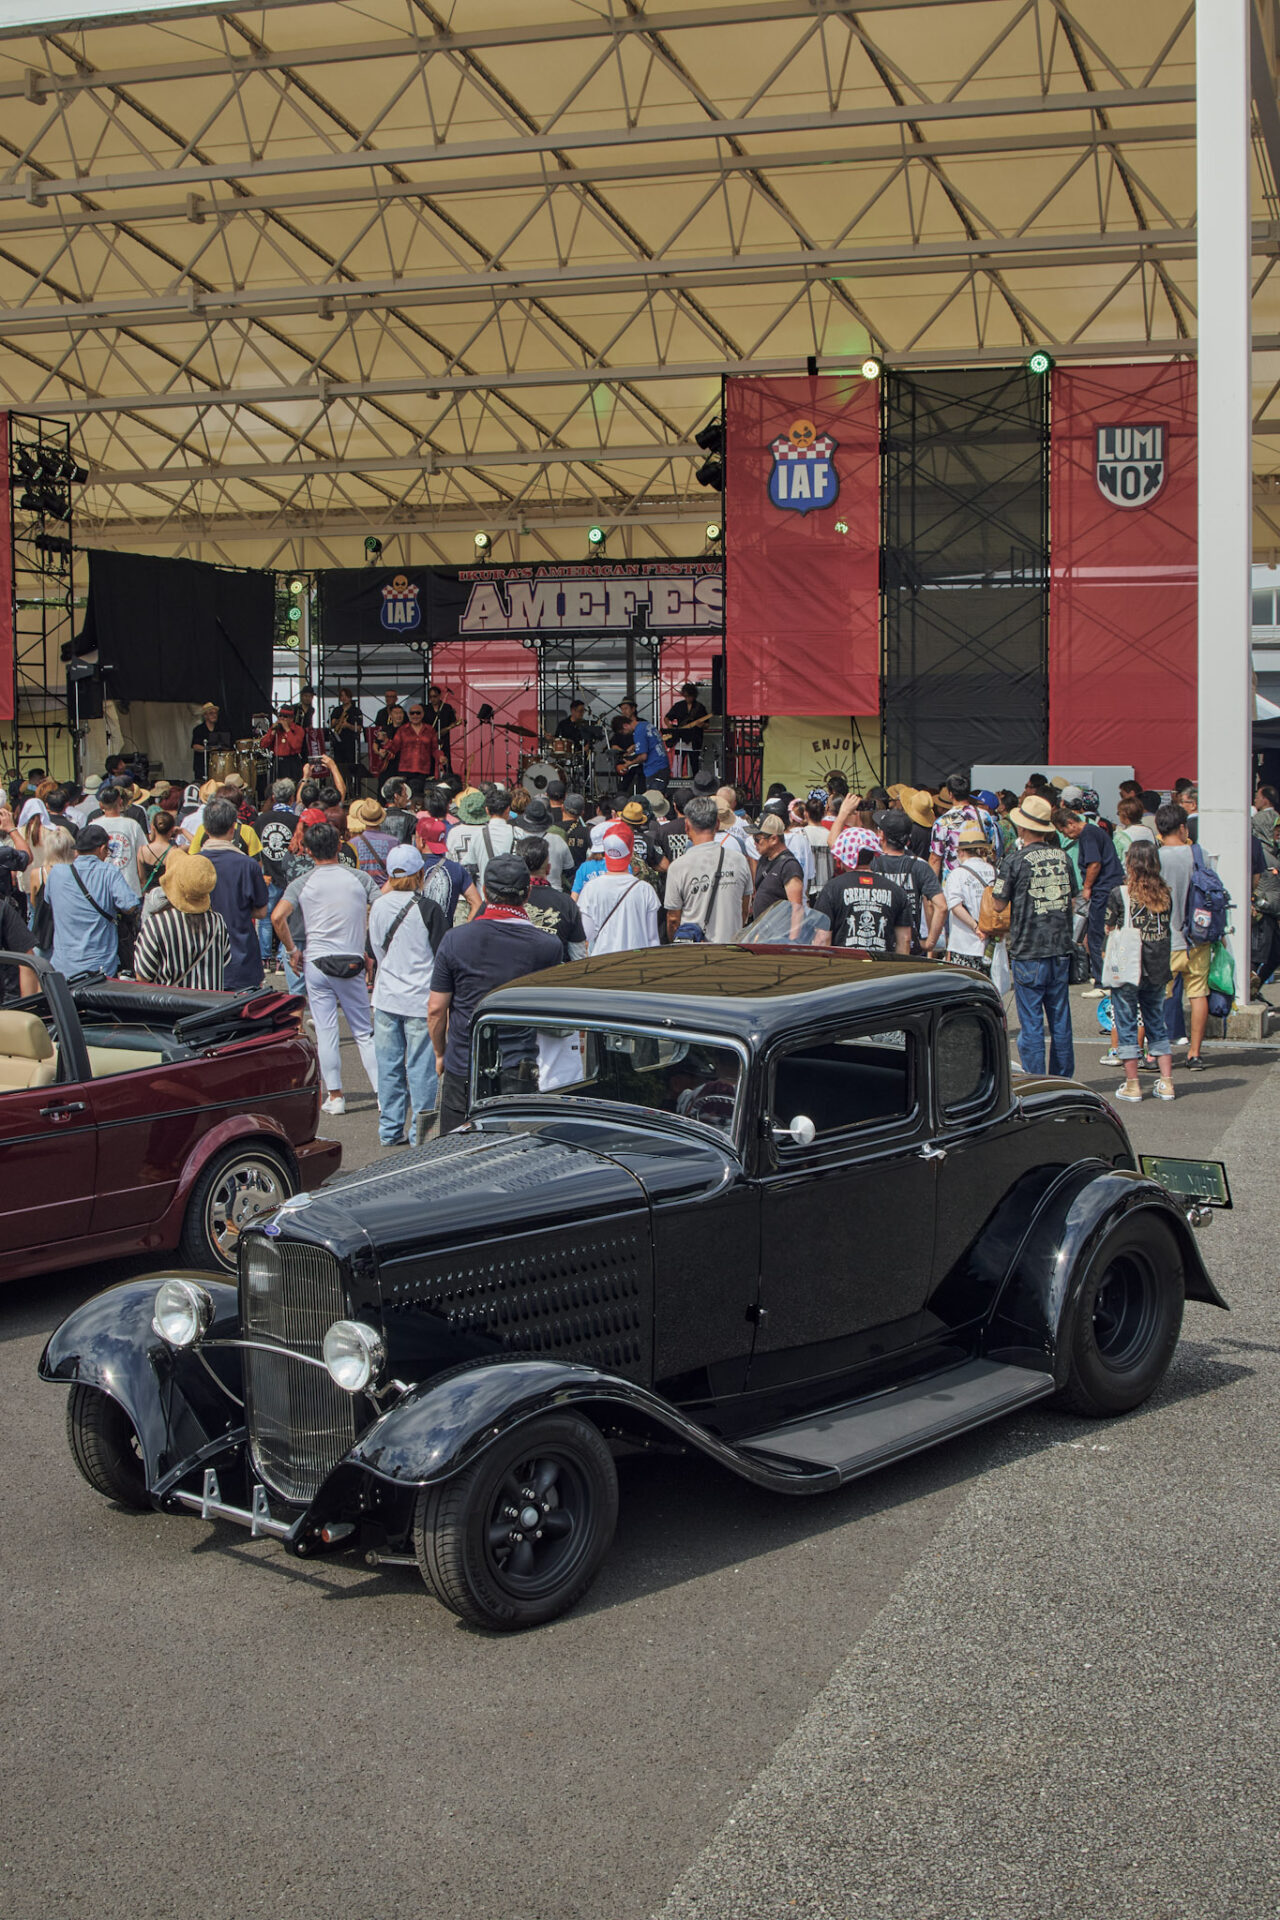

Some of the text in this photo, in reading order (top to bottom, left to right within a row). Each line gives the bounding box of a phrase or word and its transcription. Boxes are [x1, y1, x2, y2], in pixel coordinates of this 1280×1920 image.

[1098, 427, 1162, 461] LUMI
[778, 463, 829, 500] IAF
[1099, 464, 1162, 501] NOX
[458, 567, 533, 582] IKURA'S
[535, 564, 639, 578] AMERICAN
[387, 601, 416, 625] IAF
[459, 575, 724, 634] AMEFES
[812, 738, 861, 753] ENJOY
[843, 888, 871, 906] CREAM
[871, 888, 892, 908] SODA
